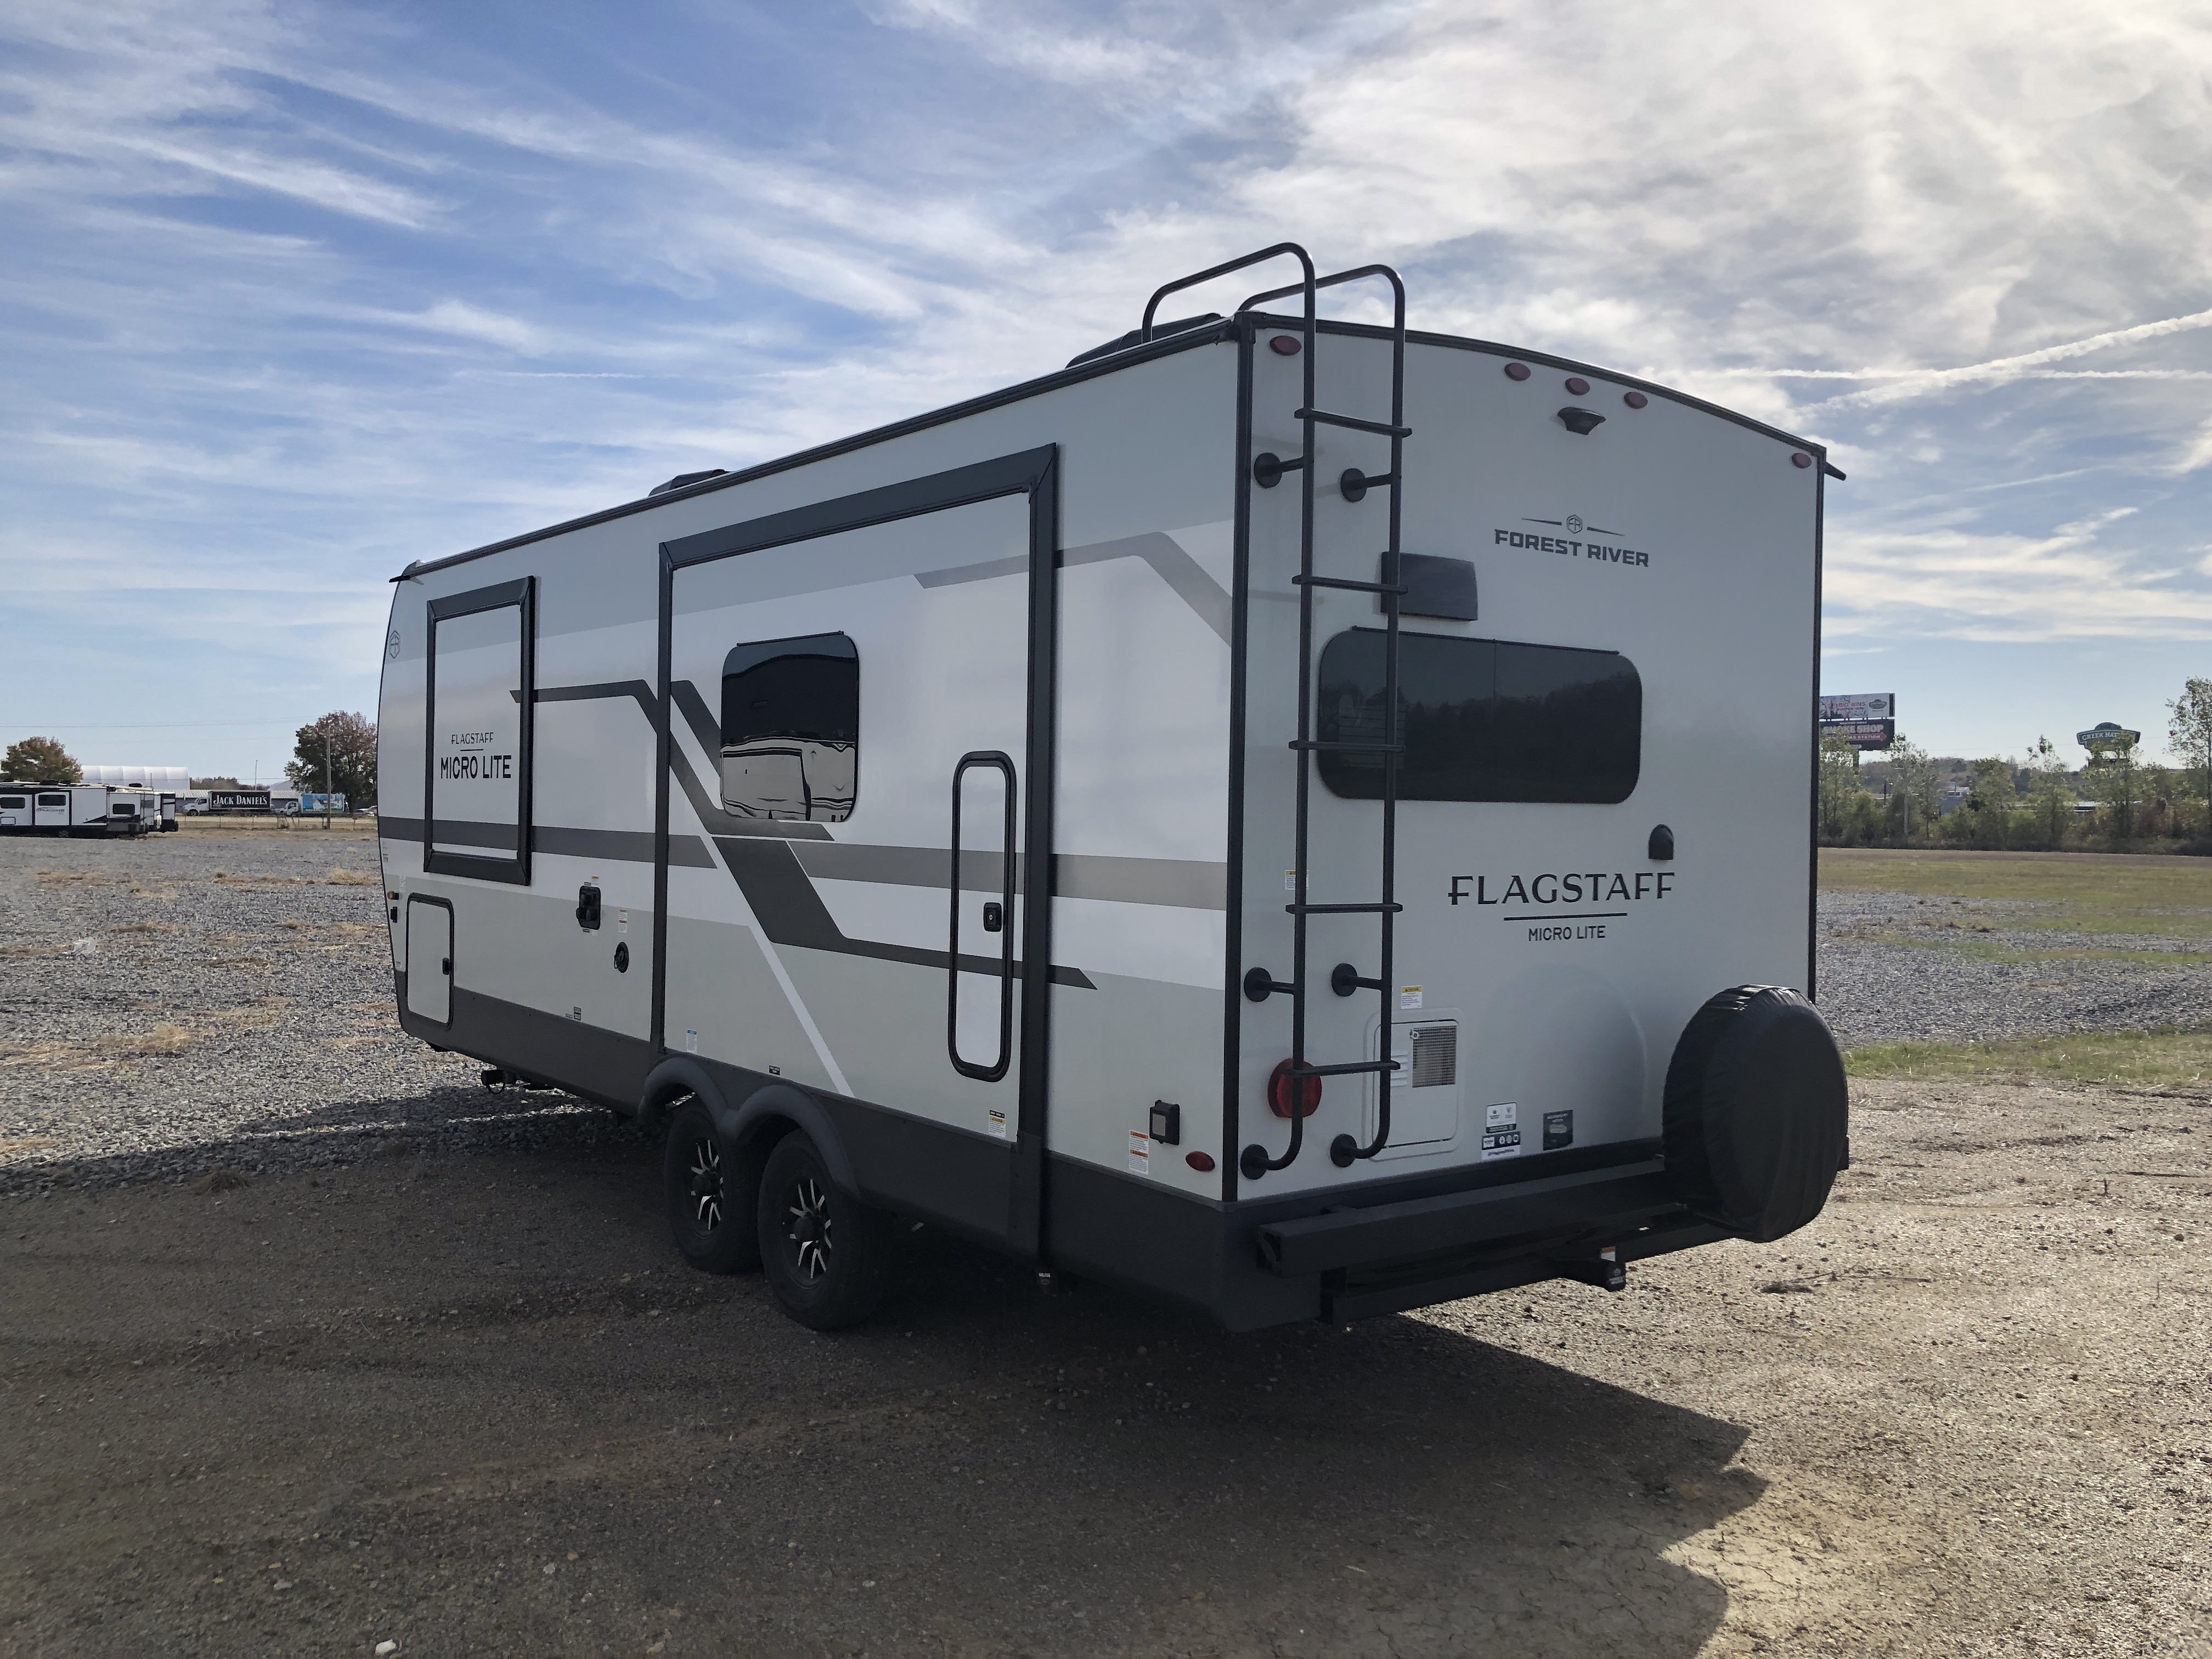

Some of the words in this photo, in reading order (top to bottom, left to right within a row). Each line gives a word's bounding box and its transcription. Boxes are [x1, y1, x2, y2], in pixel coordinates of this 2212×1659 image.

[1494, 529, 1582, 556] FOREST
[1587, 544, 1649, 567] RIVER
[1822, 725, 1856, 735] SMKE
[1857, 724, 1884, 733] SHOP
[451, 732, 494, 745] FLAGSTAFF
[441, 755, 478, 780] MICRO
[482, 755, 512, 779] LITE
[213, 795, 234, 805] JACK
[236, 795, 267, 805] DANIEL'S
[1448, 872, 1675, 906] FLAGSTAFF
[1528, 926, 1572, 941] MICRO
[1577, 925, 1606, 939] LITE
